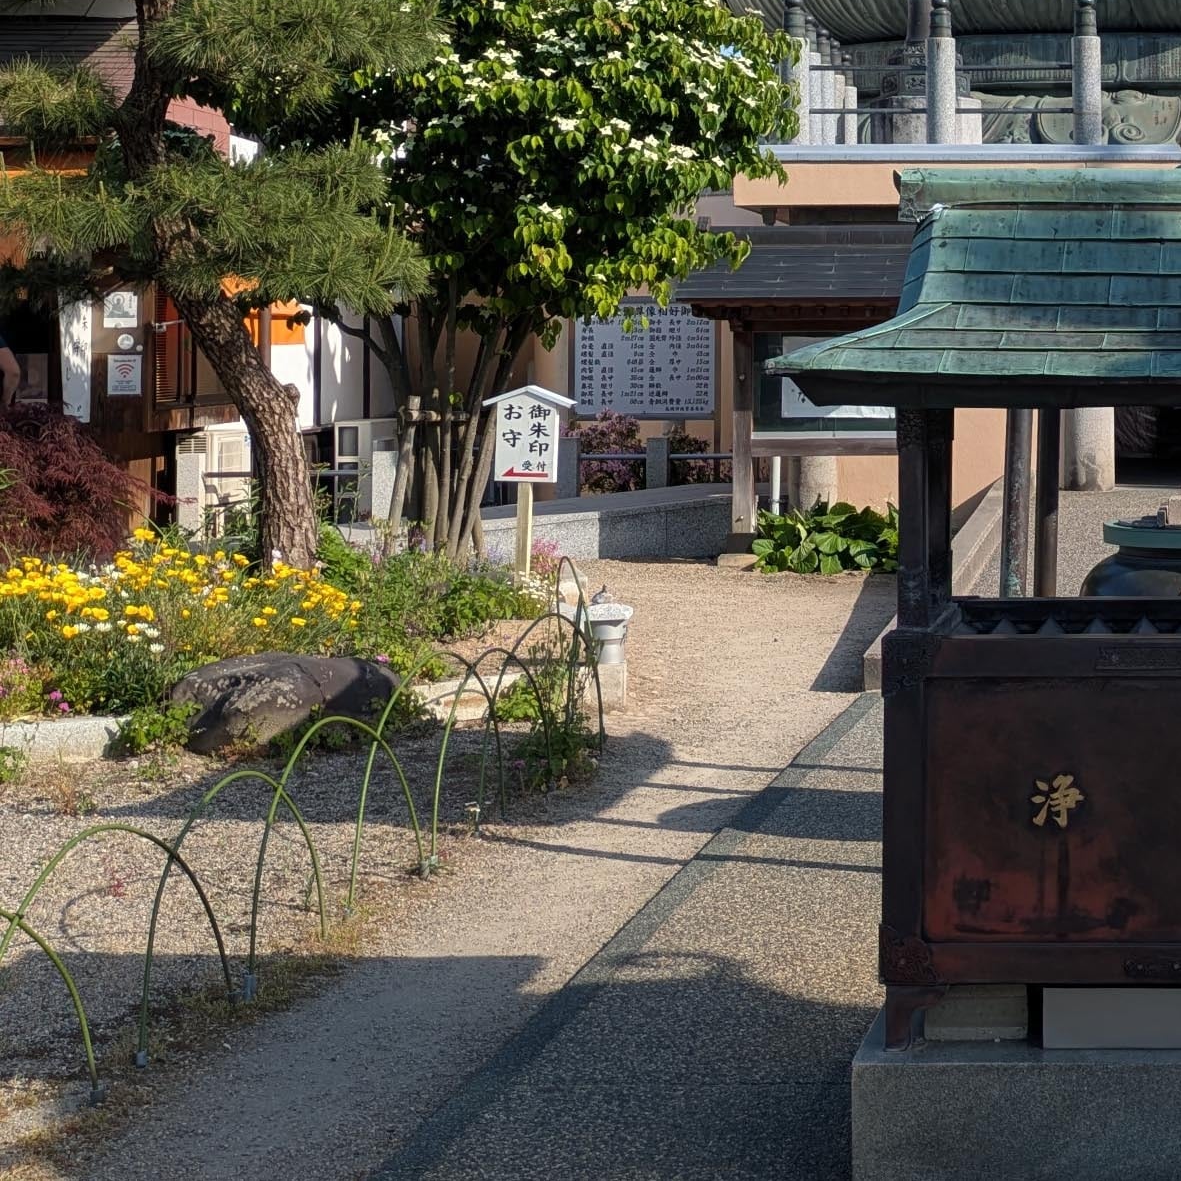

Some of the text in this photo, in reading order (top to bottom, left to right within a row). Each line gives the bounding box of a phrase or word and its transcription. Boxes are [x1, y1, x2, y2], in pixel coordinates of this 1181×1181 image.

[502, 404, 523, 448] お守
[527, 404, 551, 457] 御朱印
[522, 460, 547, 472] 受付
[1031, 774, 1084, 829] 浄
